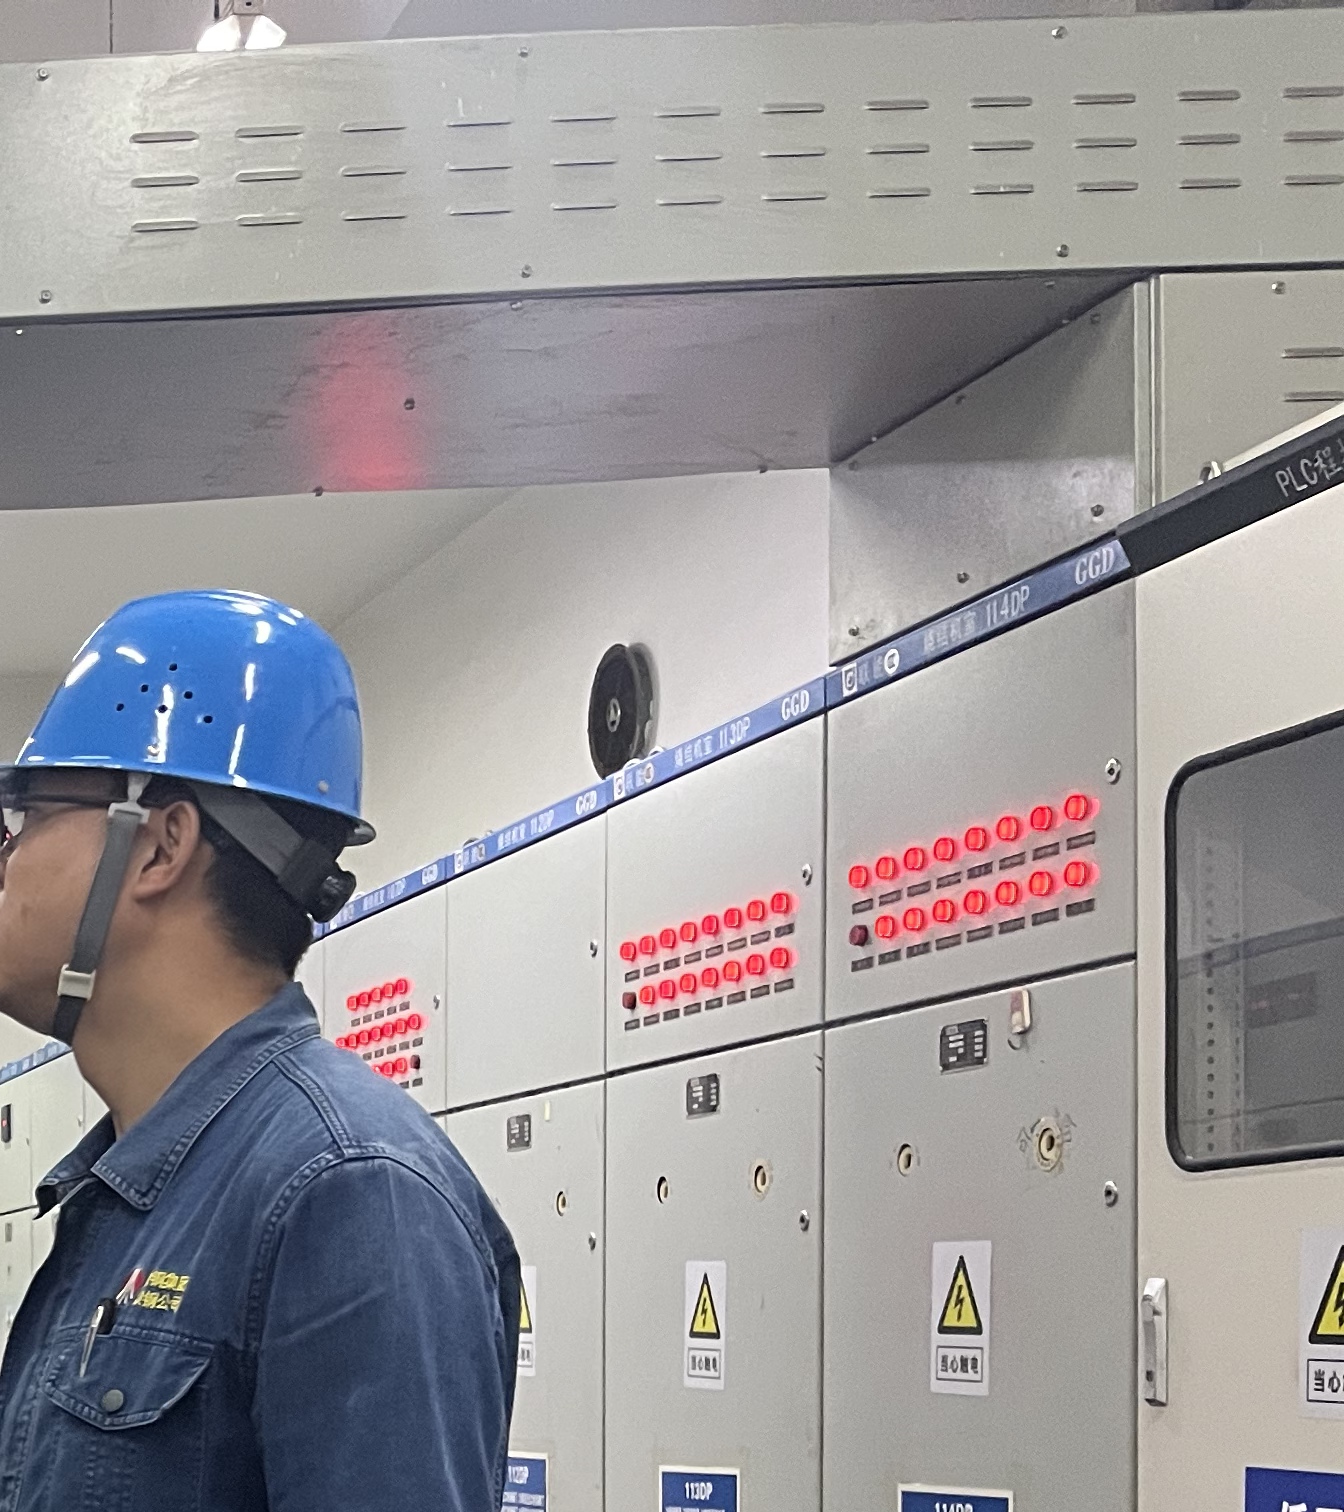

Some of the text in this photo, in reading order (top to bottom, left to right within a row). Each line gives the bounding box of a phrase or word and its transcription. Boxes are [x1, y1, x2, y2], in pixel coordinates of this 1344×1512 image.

[1275, 438, 1344, 497] PLC程
[985, 547, 1115, 628] 114DP GGD
[781, 689, 810, 721] GGD
[1314, 1368, 1344, 1393] 当心
